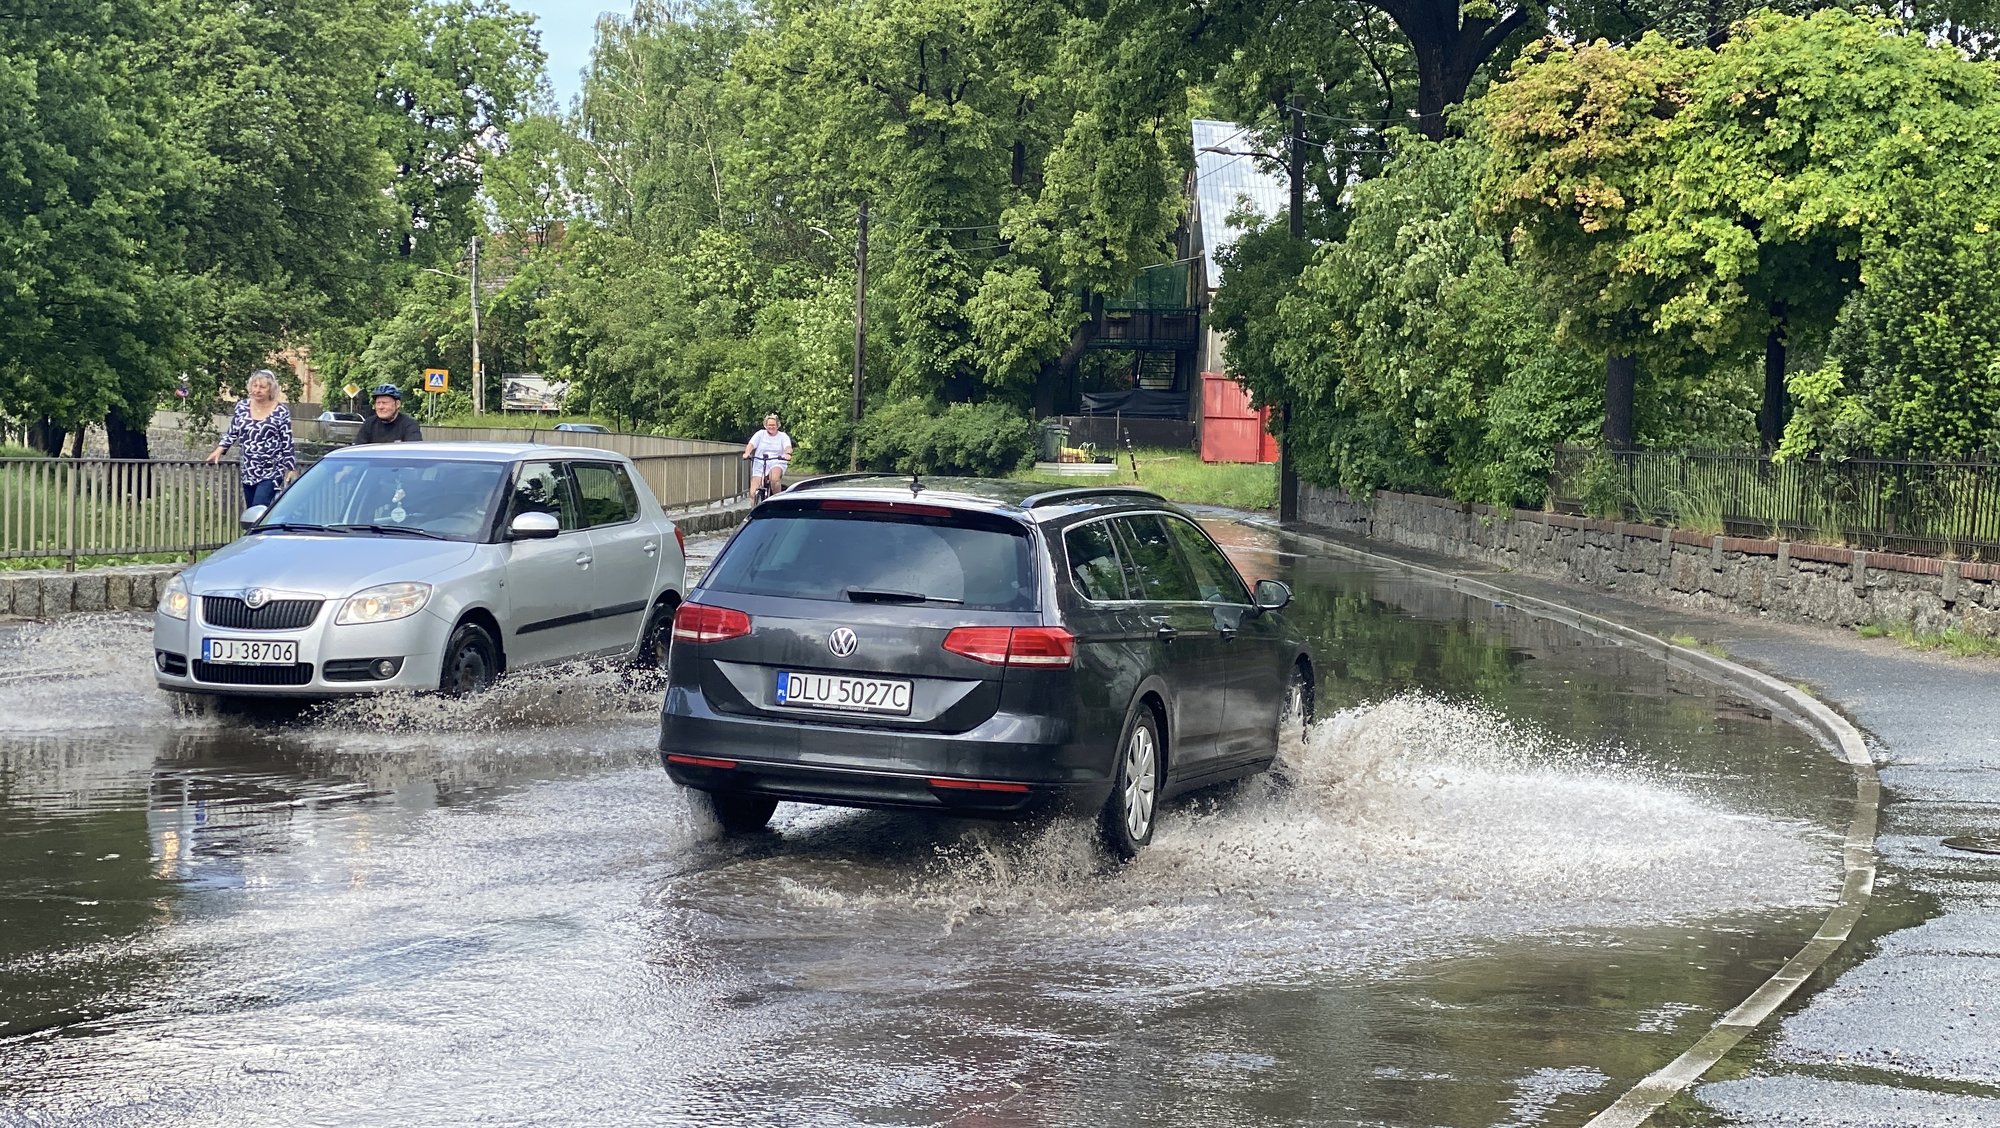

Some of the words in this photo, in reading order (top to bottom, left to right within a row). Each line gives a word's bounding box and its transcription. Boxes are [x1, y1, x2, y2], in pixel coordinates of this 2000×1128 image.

[213, 642, 232, 659] DJ
[241, 642, 292, 661] 38706
[789, 676, 831, 701] DLU
[838, 681, 906, 708] 5027C
